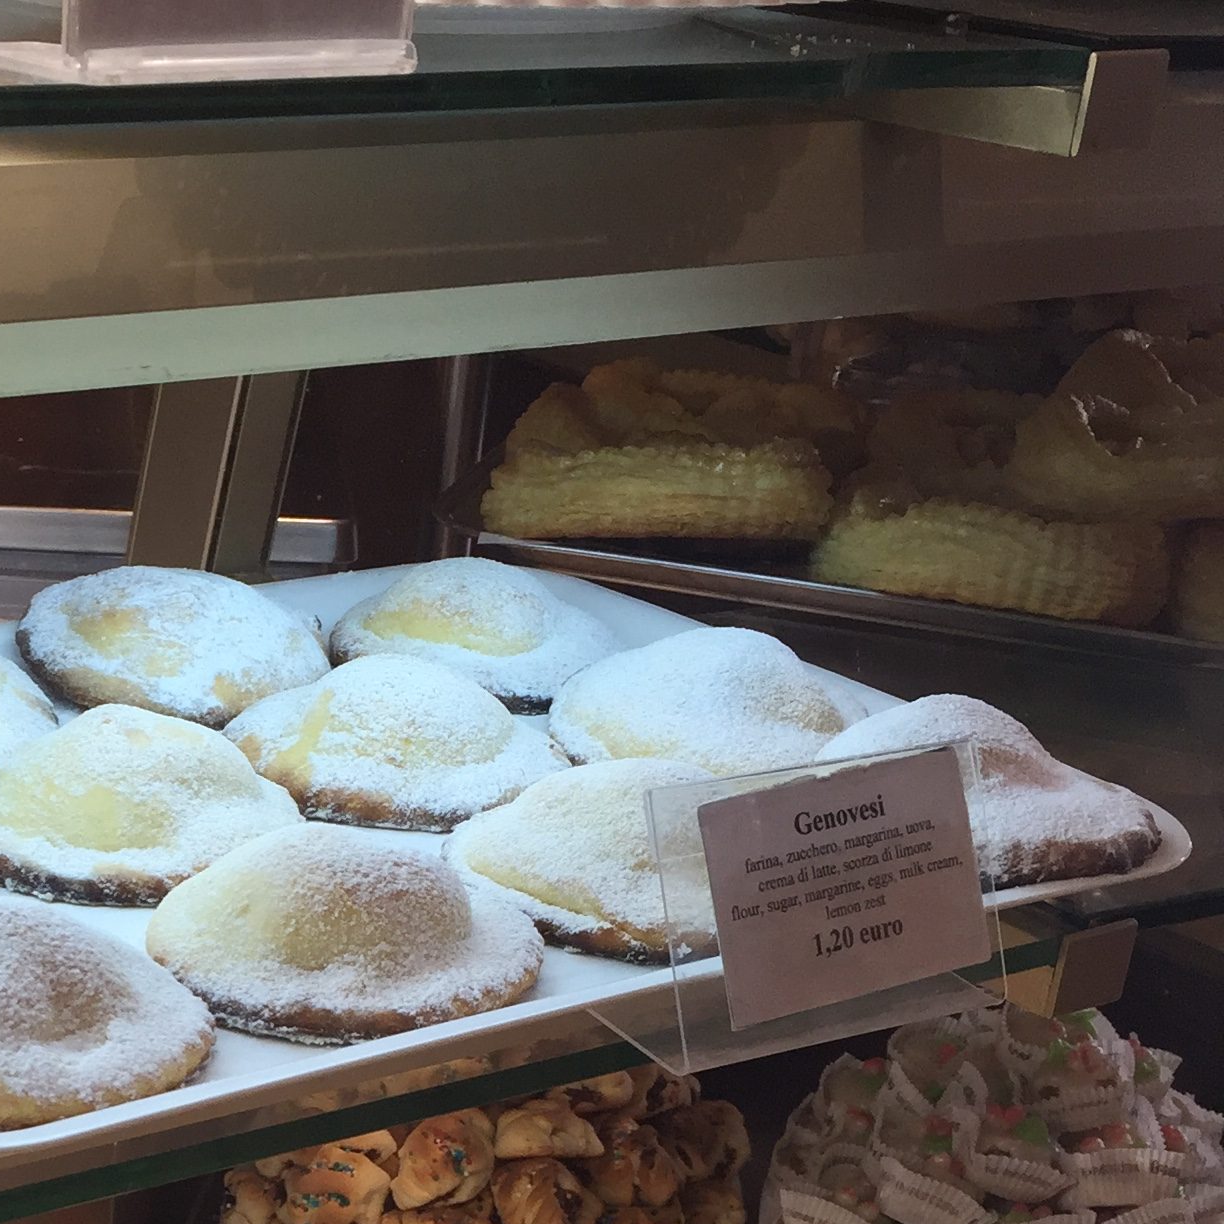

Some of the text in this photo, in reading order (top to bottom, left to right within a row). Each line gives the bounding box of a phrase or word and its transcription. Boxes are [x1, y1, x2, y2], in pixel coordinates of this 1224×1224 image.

[794, 794, 886, 836] Genovesi
[745, 855, 783, 874] farina,
[844, 826, 903, 850] margarina,
[905, 819, 936, 835] uova,
[758, 840, 934, 893] crema di latte, scorza di limone
[731, 904, 765, 922] flour,
[767, 896, 802, 913] sugar,
[804, 880, 865, 902] margarine,
[899, 861, 926, 880] milk
[927, 855, 964, 873] cream,
[826, 894, 887, 920] lemon zest
[812, 918, 904, 958] 1,20 euro
